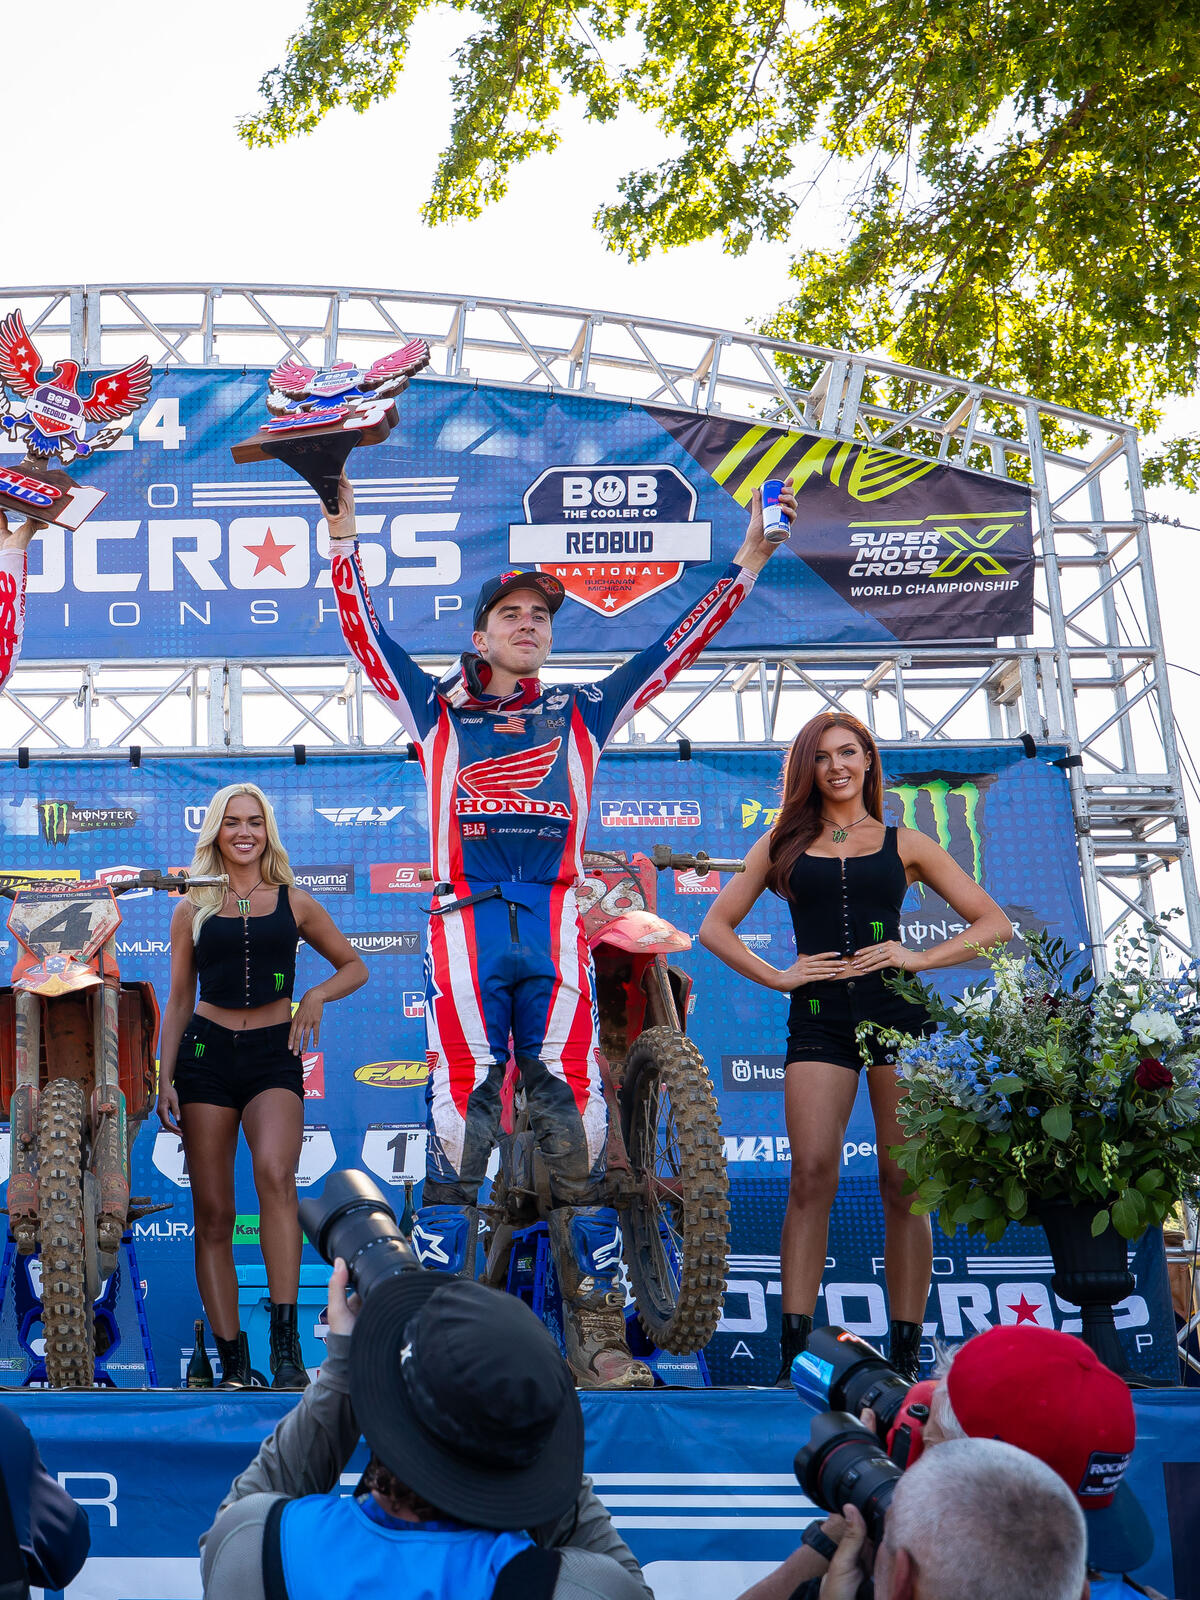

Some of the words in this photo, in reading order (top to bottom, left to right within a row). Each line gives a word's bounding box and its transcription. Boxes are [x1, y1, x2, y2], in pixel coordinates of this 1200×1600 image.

[42, 405, 67, 420] REDBUD
[343, 398, 395, 430] 3
[562, 475, 658, 507] BOB
[53, 486, 108, 530] 1
[563, 510, 586, 519] THE
[590, 509, 639, 519] COOLER
[566, 531, 653, 555] REDBUD
[849, 531, 942, 547] SUPER
[855, 546, 938, 562] MOTO
[556, 567, 665, 577] NATIONAL
[848, 560, 940, 577] CROSS
[850, 585, 902, 597] WORLD
[905, 580, 1020, 595] CHAMPIONSHIP
[665, 577, 734, 651] HONDA
[71, 810, 134, 821] MONSTER
[315, 806, 406, 821] FLY
[456, 799, 572, 820] HONDA
[601, 801, 699, 816] PARTS
[602, 816, 700, 826] UNLIMITED
[295, 874, 348, 886] sqvarna
[574, 877, 646, 917] 96
[28, 902, 94, 951] 4
[347, 936, 402, 949] TRIUMPH
